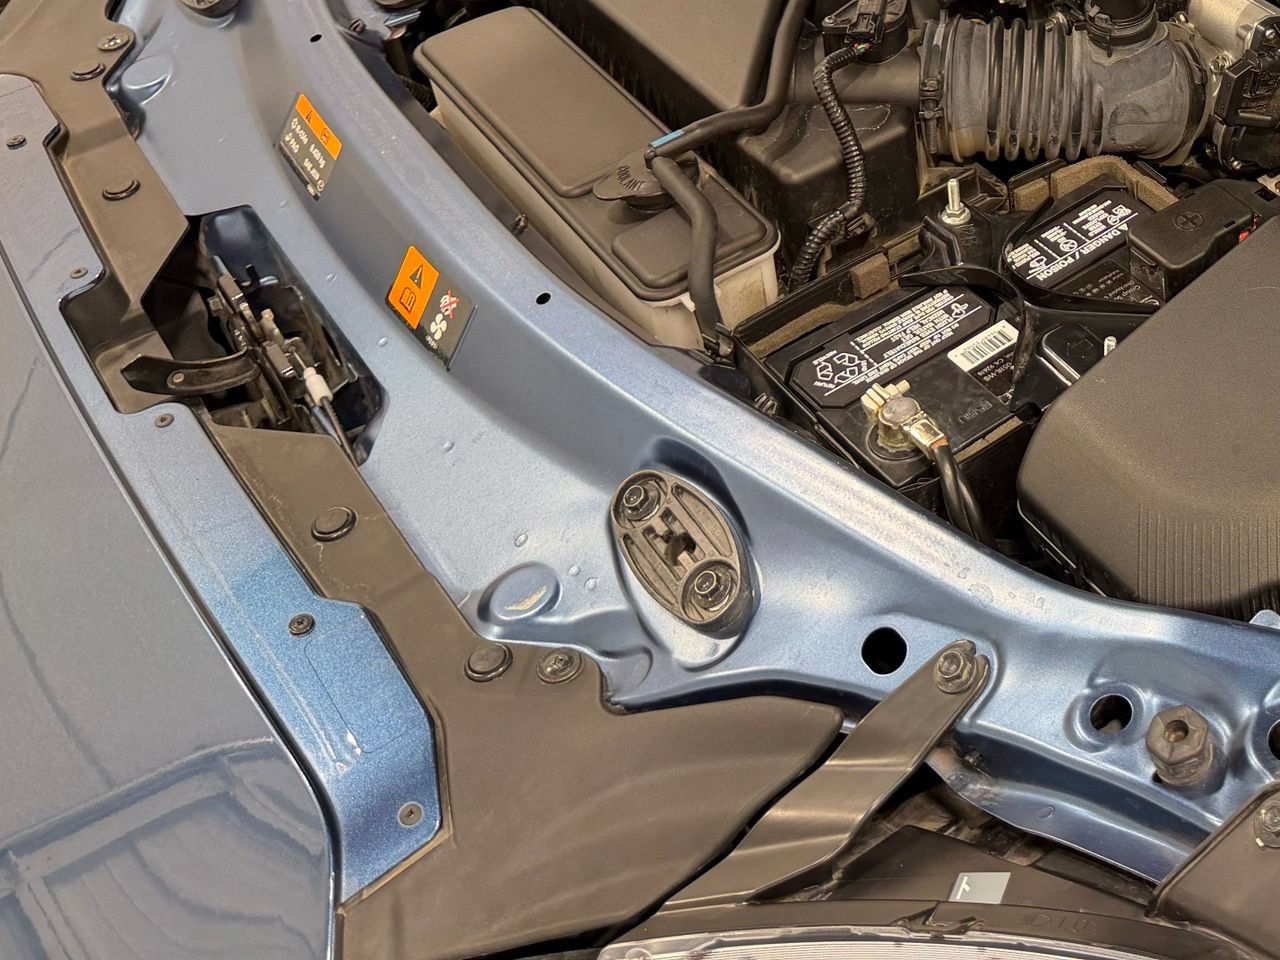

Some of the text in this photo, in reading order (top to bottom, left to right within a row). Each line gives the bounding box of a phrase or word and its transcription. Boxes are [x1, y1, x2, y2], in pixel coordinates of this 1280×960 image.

[618, 164, 645, 192] COOLANT
[1082, 212, 1108, 230] EXPLOSIVE
[1081, 230, 1121, 255] DANGER
[1036, 255, 1075, 281] POISON
[1120, 283, 1141, 297] Group
[889, 309, 945, 342] MEDICAL HELP FAST
[933, 313, 949, 323] WITH
[881, 316, 954, 358] FLUSH EYES IMMEDIATELY
[900, 333, 913, 342] GET
[811, 349, 837, 365] RECYCLE
